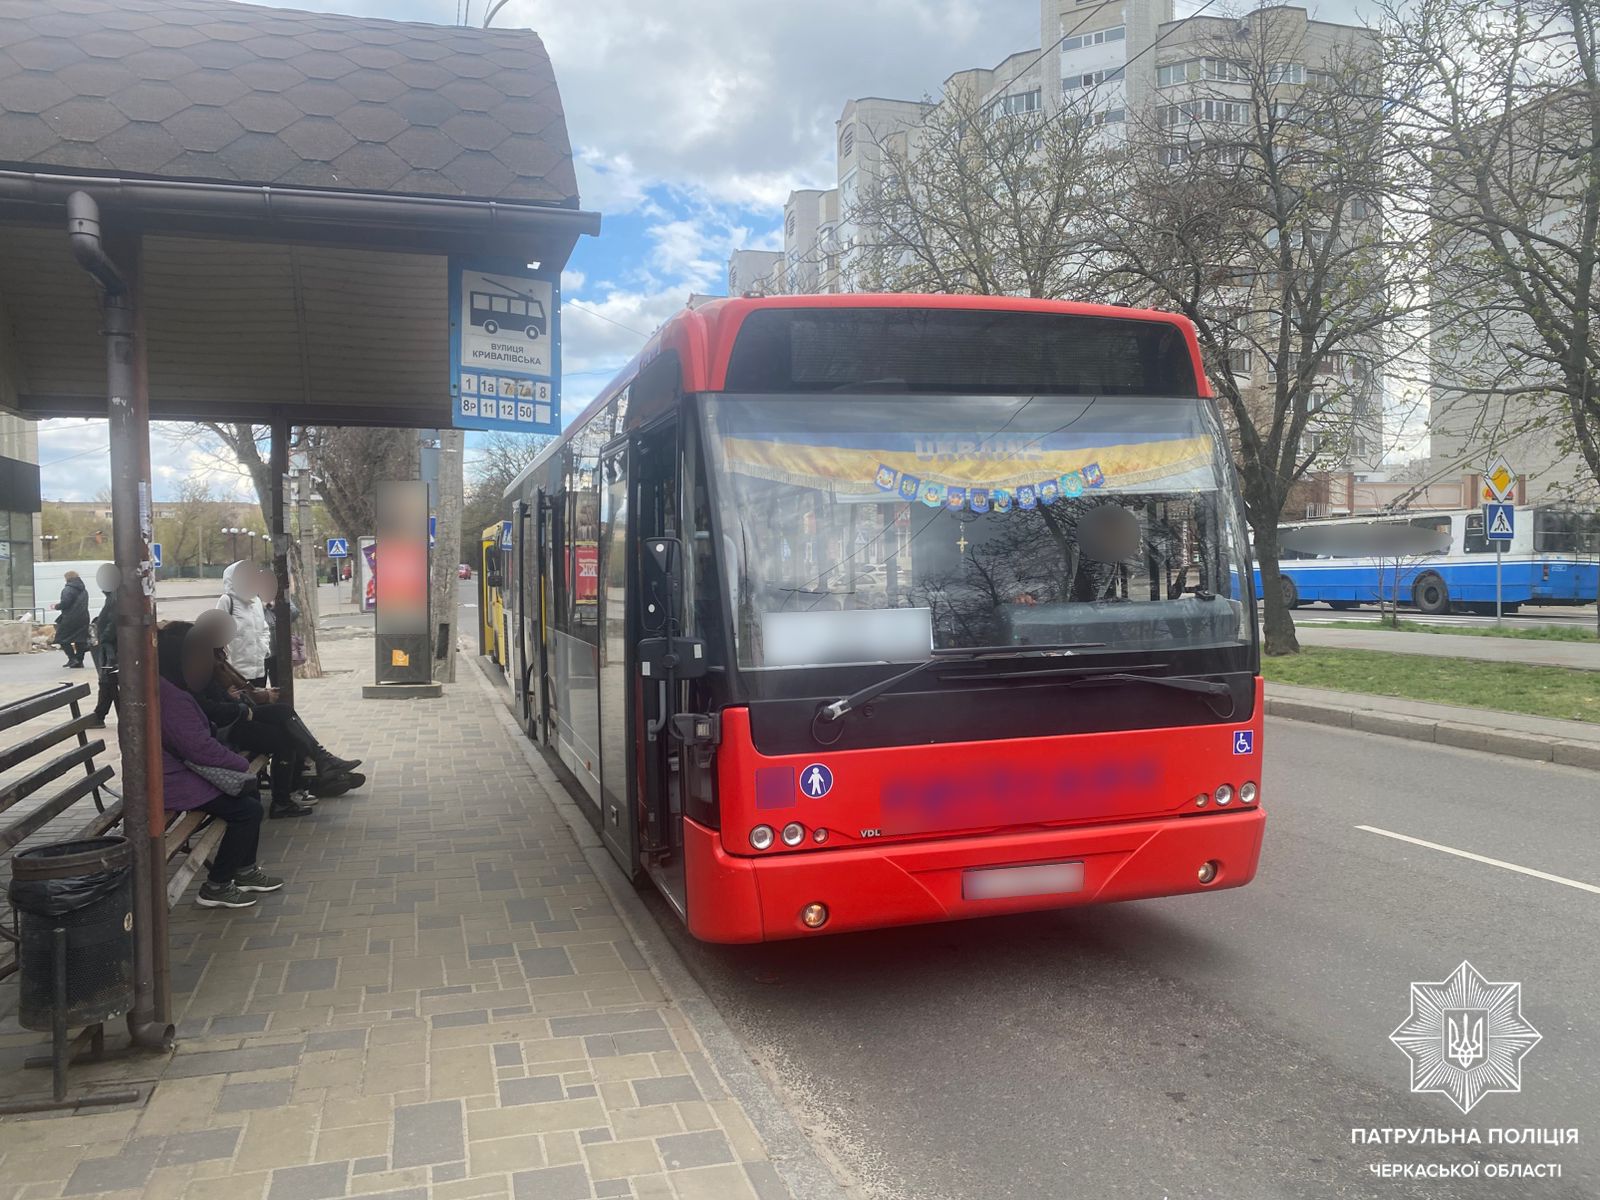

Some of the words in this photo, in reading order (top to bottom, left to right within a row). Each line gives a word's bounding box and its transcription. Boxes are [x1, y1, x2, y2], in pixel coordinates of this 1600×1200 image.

[490, 343, 524, 353] ВУЛИЦЯ
[472, 350, 541, 365] КРИВАЛІВСЬКА
[466, 378, 472, 390] 1
[503, 383, 511, 394] 7
[539, 387, 546, 398] 8
[483, 402, 494, 414] 11
[501, 404, 513, 416] 12
[519, 406, 532, 418] 50
[914, 440, 1042, 461] UKRAINE
[860, 829, 880, 838] VDL
